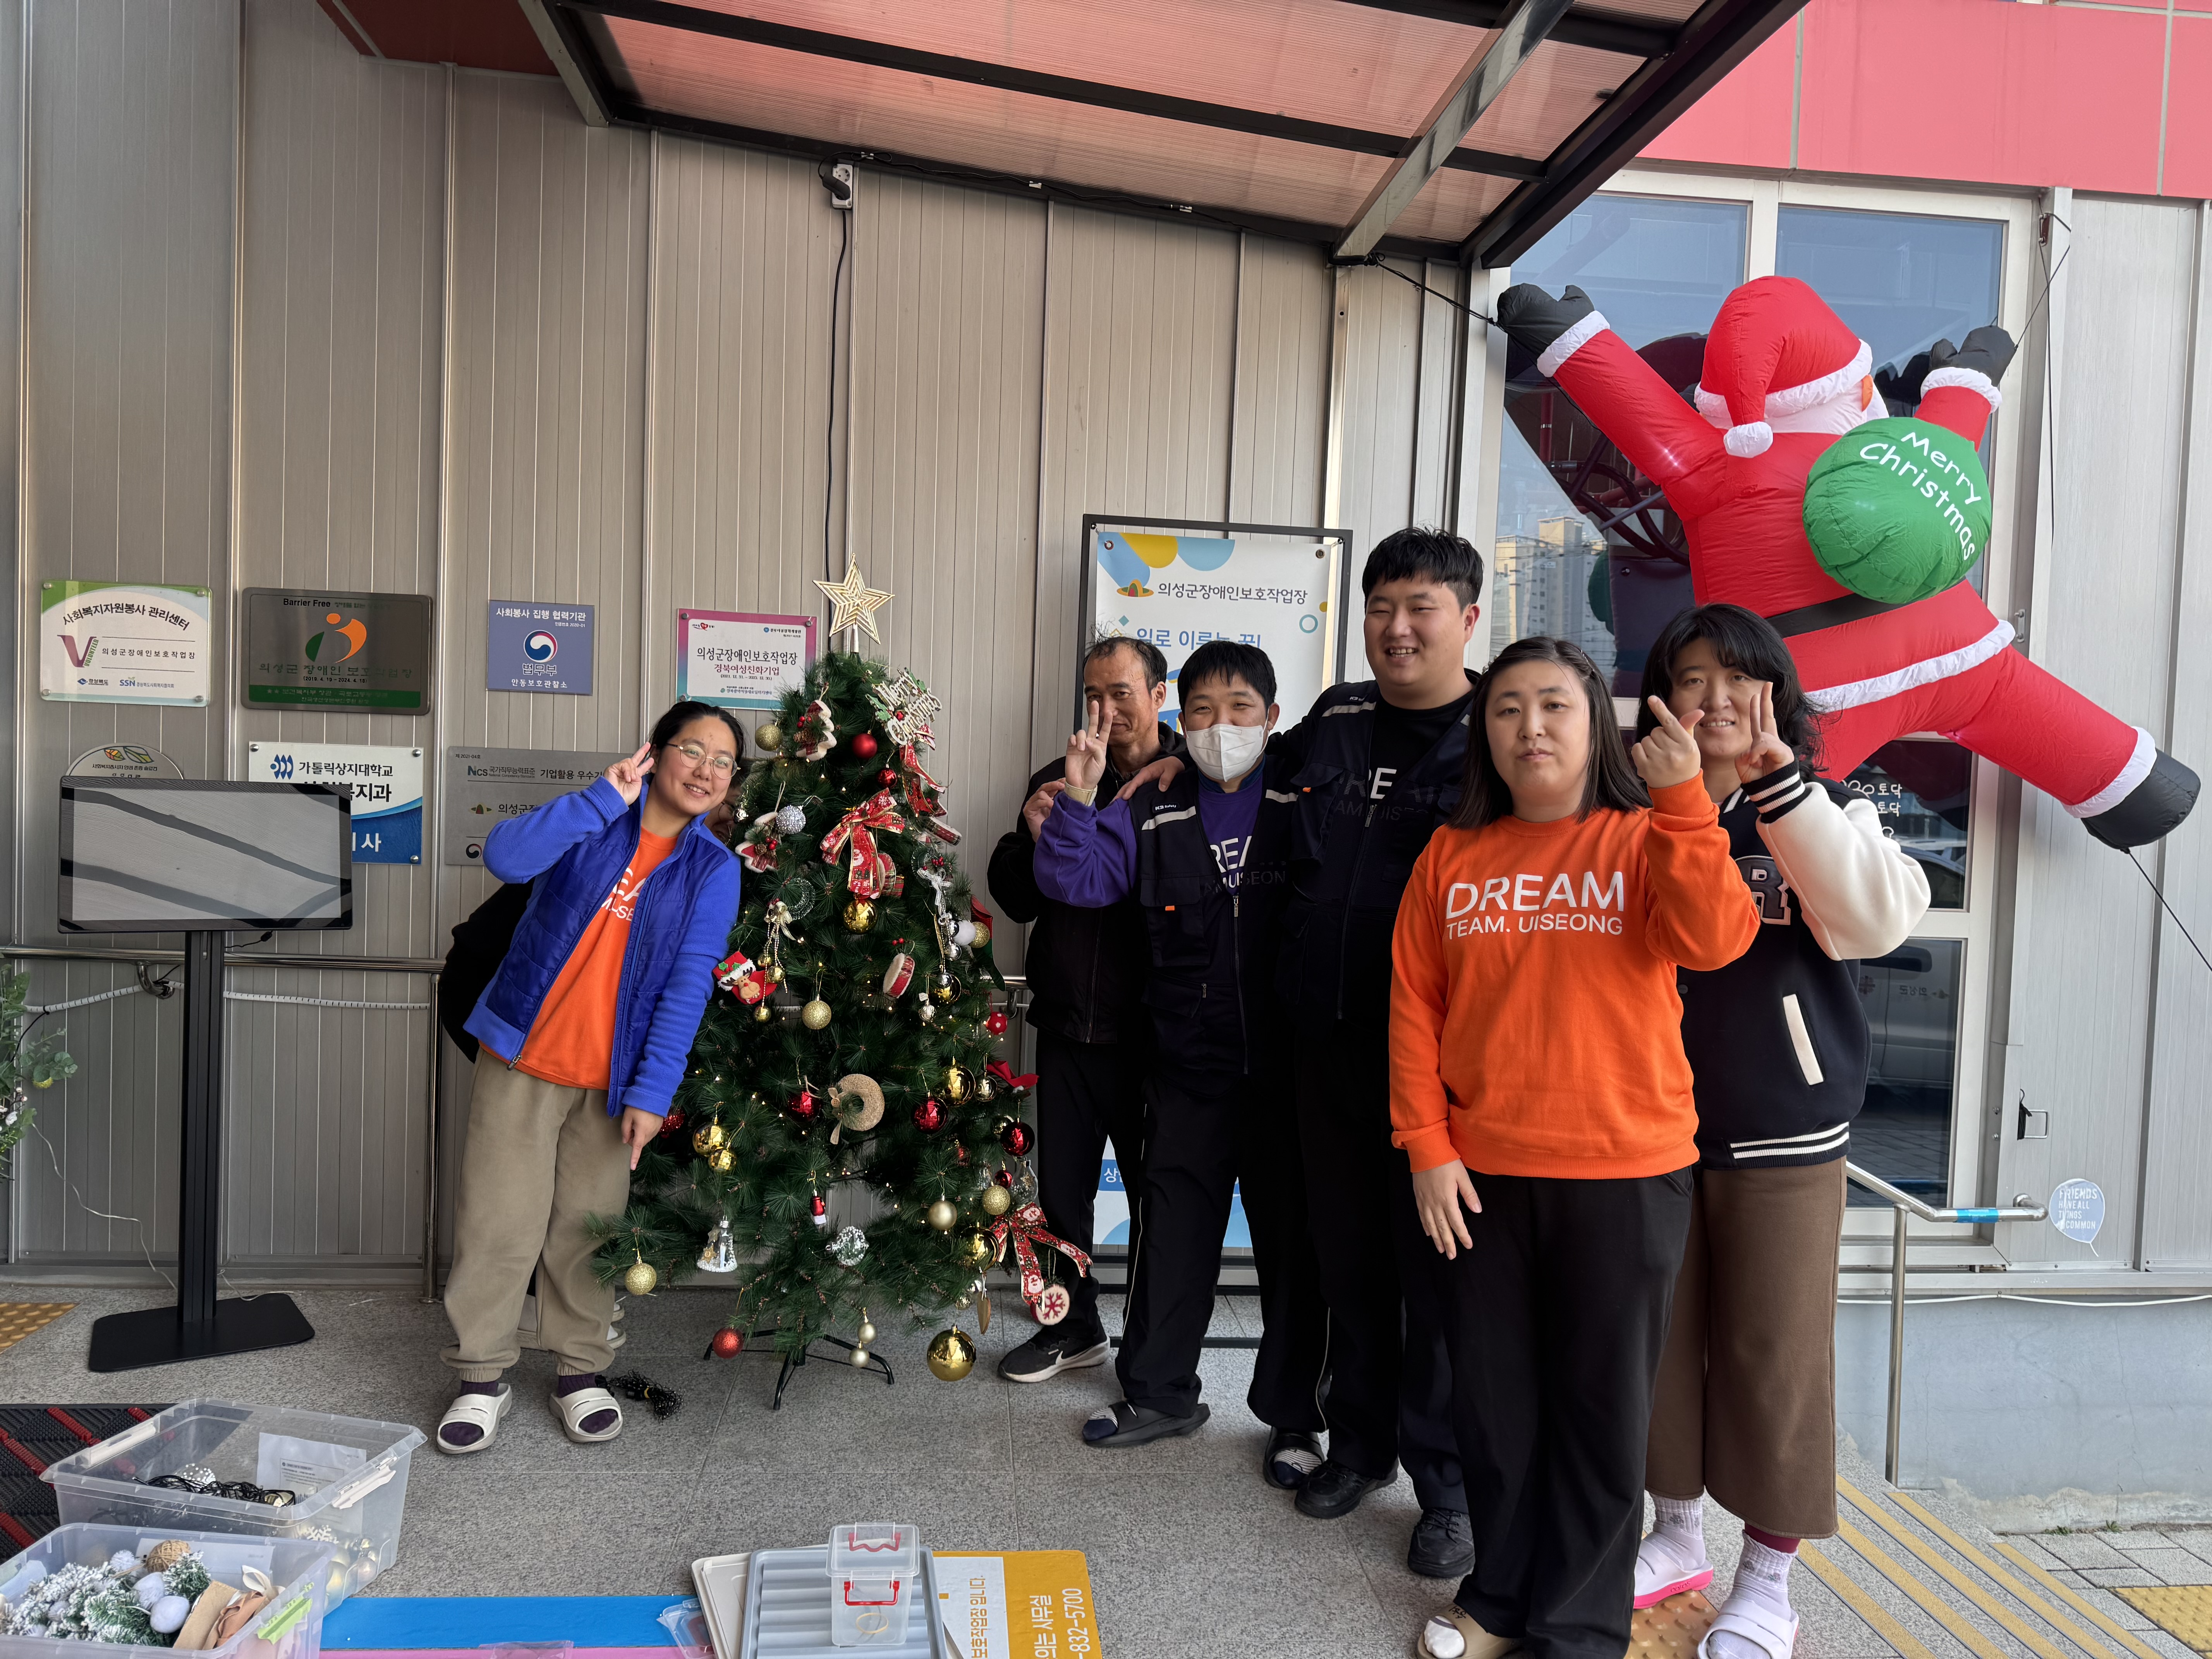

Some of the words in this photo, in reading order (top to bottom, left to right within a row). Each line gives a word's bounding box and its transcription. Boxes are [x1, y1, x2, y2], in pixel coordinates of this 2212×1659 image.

[1901, 431, 1981, 505] Merry
[1860, 443, 1975, 560] Christmas
[1158, 582, 1308, 605] 의성군장애인보호작업장
[283, 598, 311, 606] Barrier
[62, 603, 145, 625] 사회복지자원봉사
[148, 607, 190, 631] 관리센터
[496, 608, 530, 618] 사회봉사
[533, 610, 550, 619] 집행
[553, 611, 586, 621] 협력기관
[1137, 629, 1171, 647] 일로
[84, 639, 99, 667] VOLUNTEER
[102, 648, 196, 659] 의성군장애인보호작업장
[697, 647, 798, 665] 의성군장애인보호작업장
[522, 663, 557, 677] 법무부
[714, 664, 780, 676] 경북여성친화기업
[511, 679, 567, 689] 안동보호관찰소
[299, 762, 393, 777] 가톨릭상지대학교
[489, 766, 535, 775] 국가직무능력표준
[540, 769, 574, 780] 기업활용
[577, 769, 602, 779] 우수기
[1877, 783, 1903, 799] 토닥
[1877, 801, 1901, 817] 토닥
[1446, 871, 1624, 919] DREAM
[1446, 915, 1511, 939] TEAM.
[1518, 913, 1623, 935] UISEONG
[2059, 1187, 2097, 1199] FRIENDS
[2077, 1200, 2090, 1209] ALL
[2066, 1220, 2096, 1230] COMMON
[969, 1575, 987, 1606] 입니다.
[1029, 1595, 1054, 1630] 사무실
[1033, 1633, 1058, 1659] 의는
